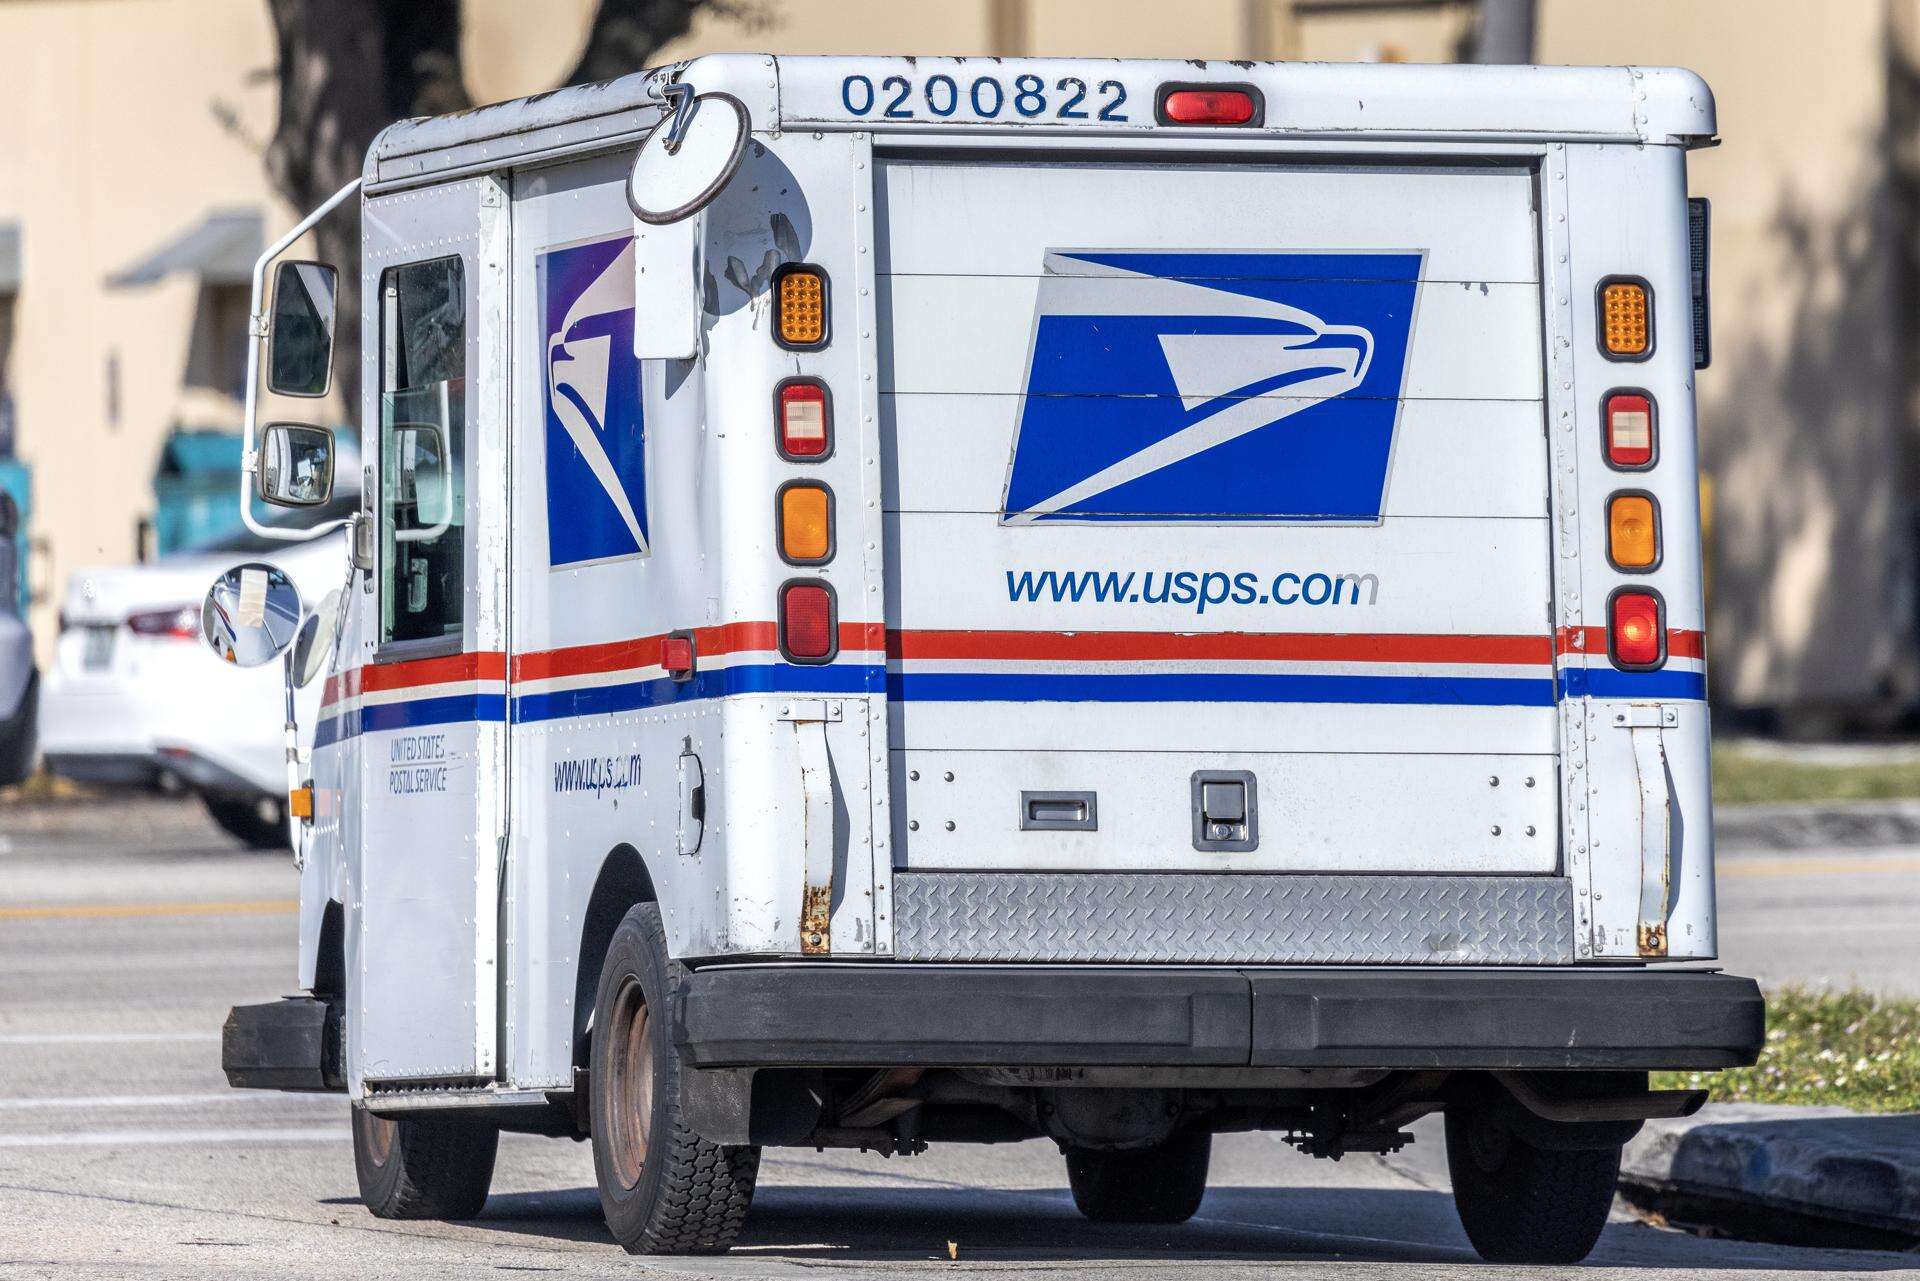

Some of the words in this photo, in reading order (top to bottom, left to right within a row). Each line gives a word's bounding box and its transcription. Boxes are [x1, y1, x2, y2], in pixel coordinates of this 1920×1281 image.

[842, 74, 1128, 122] 0200822
[1006, 571, 1379, 614] www.usps.com
[391, 737, 416, 762] UNITED
[417, 735, 445, 760] STATES
[390, 770, 414, 794] POSTAL
[415, 767, 447, 793] SERVICE
